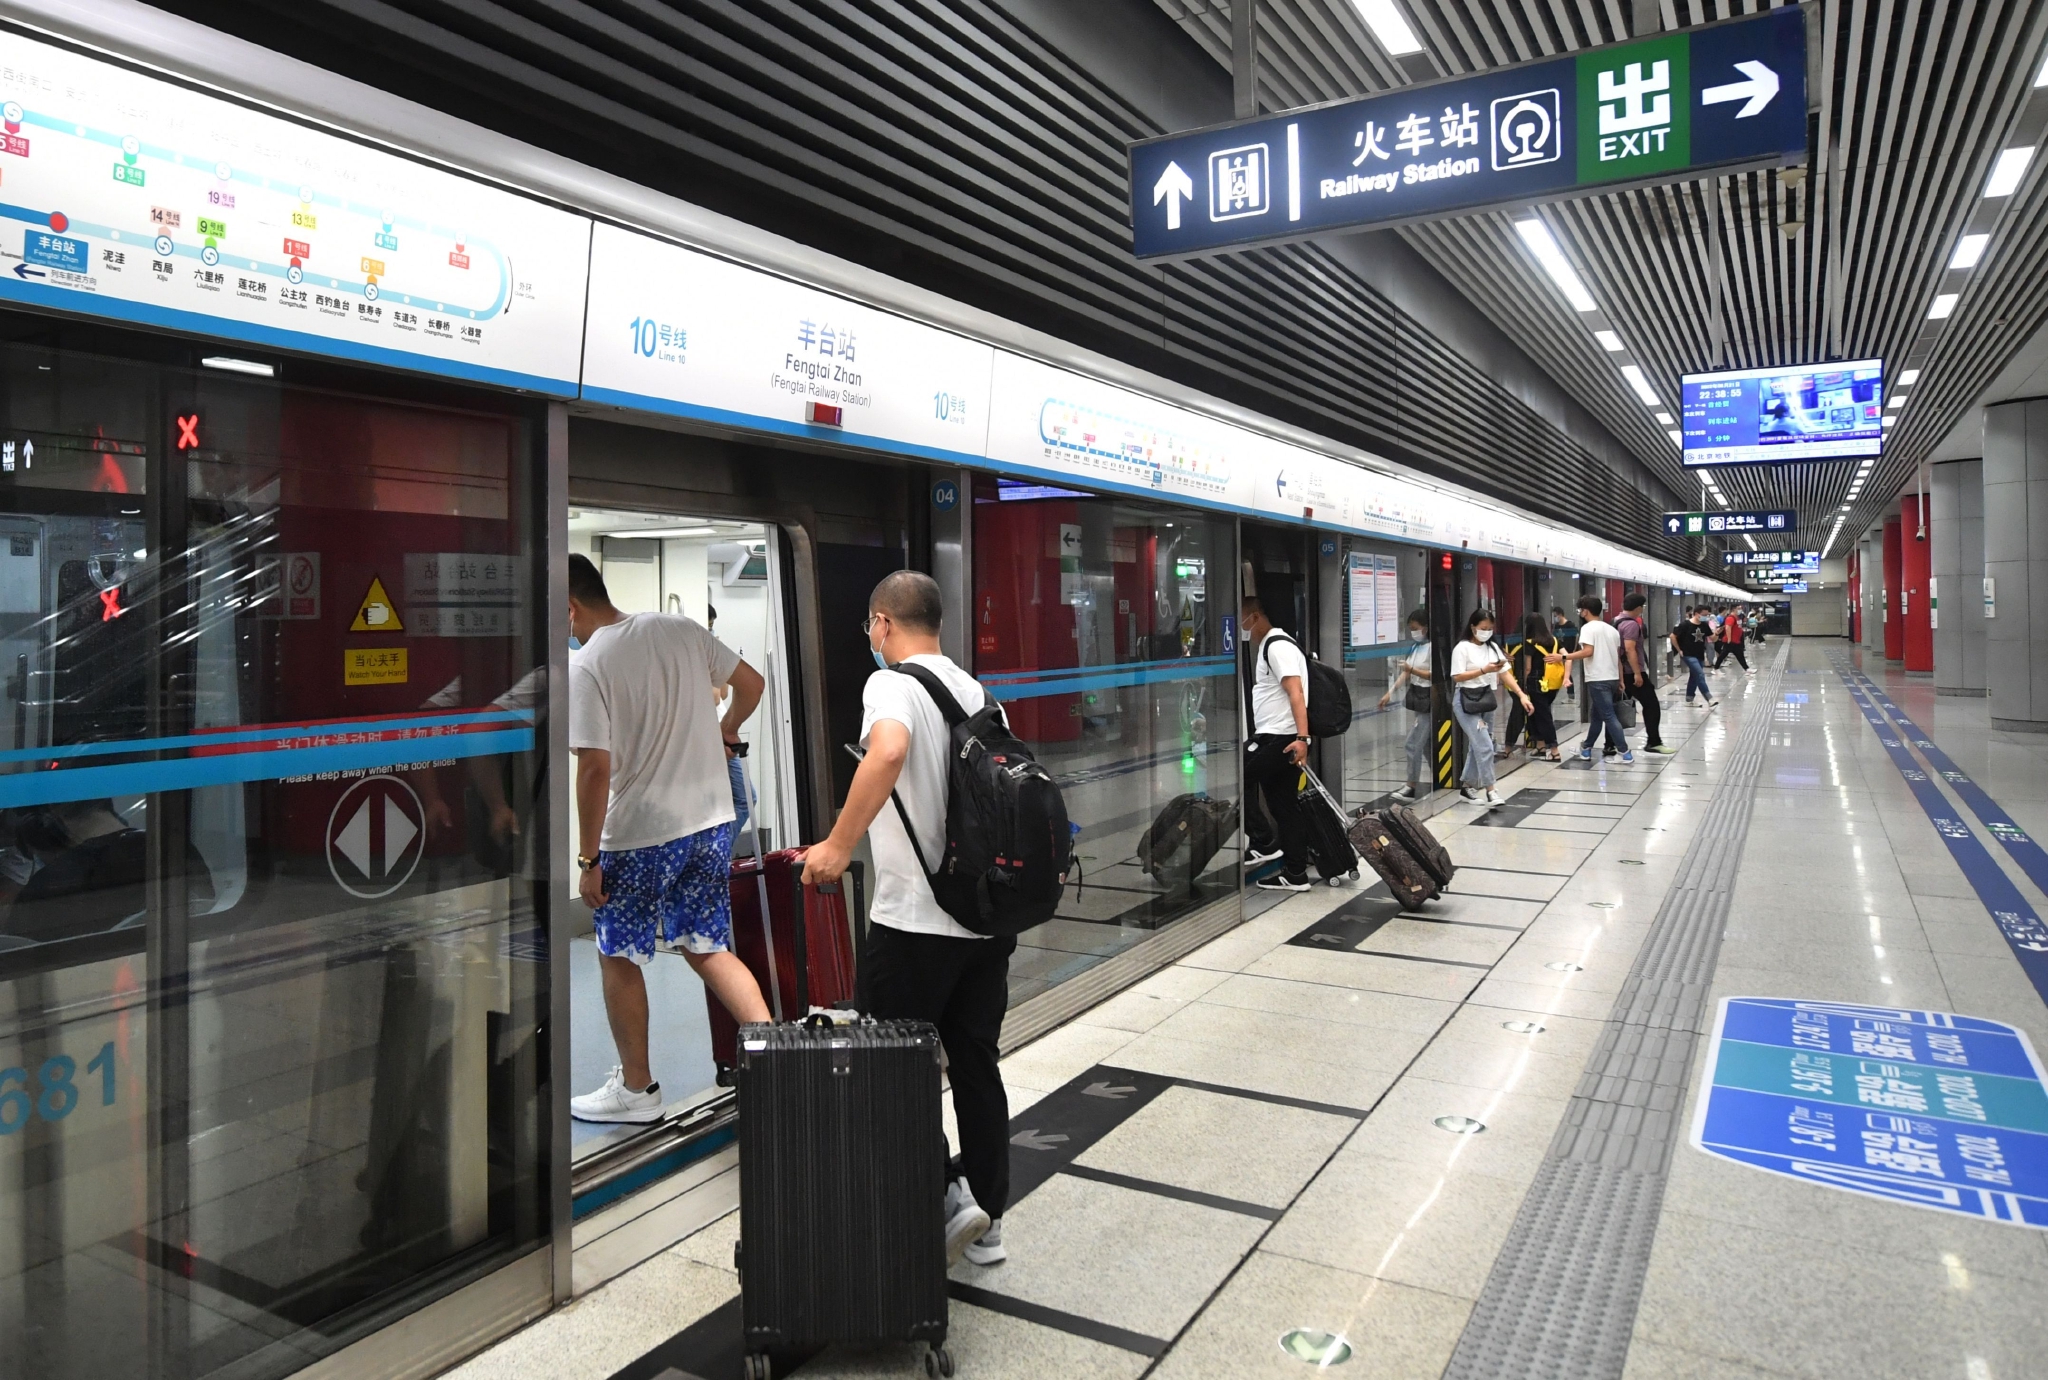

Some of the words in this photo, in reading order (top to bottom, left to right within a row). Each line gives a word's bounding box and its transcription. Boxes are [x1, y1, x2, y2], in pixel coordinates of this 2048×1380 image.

[1352, 102, 1480, 167] 火车站
[1599, 127, 1671, 161] EXIT
[1320, 169, 1400, 199] Railway
[1402, 157, 1480, 185] Station
[38, 236, 76, 254] 丰台站
[34, 248, 60, 260] Fengtai
[62, 254, 79, 263] Zhan
[103, 249, 126, 264] 泥洼
[106, 264, 121, 272] Niwa
[152, 260, 173, 274] 西局
[51, 269, 97, 286] 列车前进方向
[194, 269, 224, 284] 六里桥
[196, 282, 220, 292] Liuliqiao
[238, 278, 267, 293] 莲花桥
[519, 282, 532, 293] 外环
[280, 287, 308, 302] 公主坟
[315, 294, 350, 311] 西钓鱼台
[394, 311, 418, 325] 车道沟
[428, 318, 451, 332] 长春桥
[460, 325, 482, 338] 火器营
[798, 317, 857, 363] 丰台站
[658, 350, 676, 364] Line
[678, 354, 686, 365] 10
[785, 353, 832, 382] Fengtai
[834, 366, 862, 387] Zhan
[771, 372, 807, 396] (Fengtai
[808, 381, 840, 404] Railway
[841, 387, 872, 409] Station)
[1699, 389, 1742, 400] 22:38:55
[949, 414, 959, 424] Line
[1708, 417, 1738, 425] 列车进站
[1698, 452, 1731, 460] 北京地铁
[936, 489, 954, 503] 04
[1726, 516, 1756, 524] 火车站
[1322, 544, 1334, 552] 05
[355, 653, 400, 668] 当心夹手
[348, 670, 370, 679] Watch
[371, 670, 387, 678] Your
[388, 668, 406, 676] Hand
[279, 774, 313, 784] Please
[316, 770, 339, 781] keep
[342, 769, 366, 779] away
[369, 765, 392, 775] when
[396, 763, 408, 772] the
[411, 760, 430, 770] door
[433, 758, 456, 768] slides
[1850, 1030, 1916, 1061] 强冷
[1790, 1060, 1834, 1095] 9-16门
[0, 1041, 116, 1136] 681
[1855, 1074, 1928, 1112] 弱冷
[1788, 1113, 1837, 1152] 1-8门
[1861, 1130, 1944, 1178] 强冷
